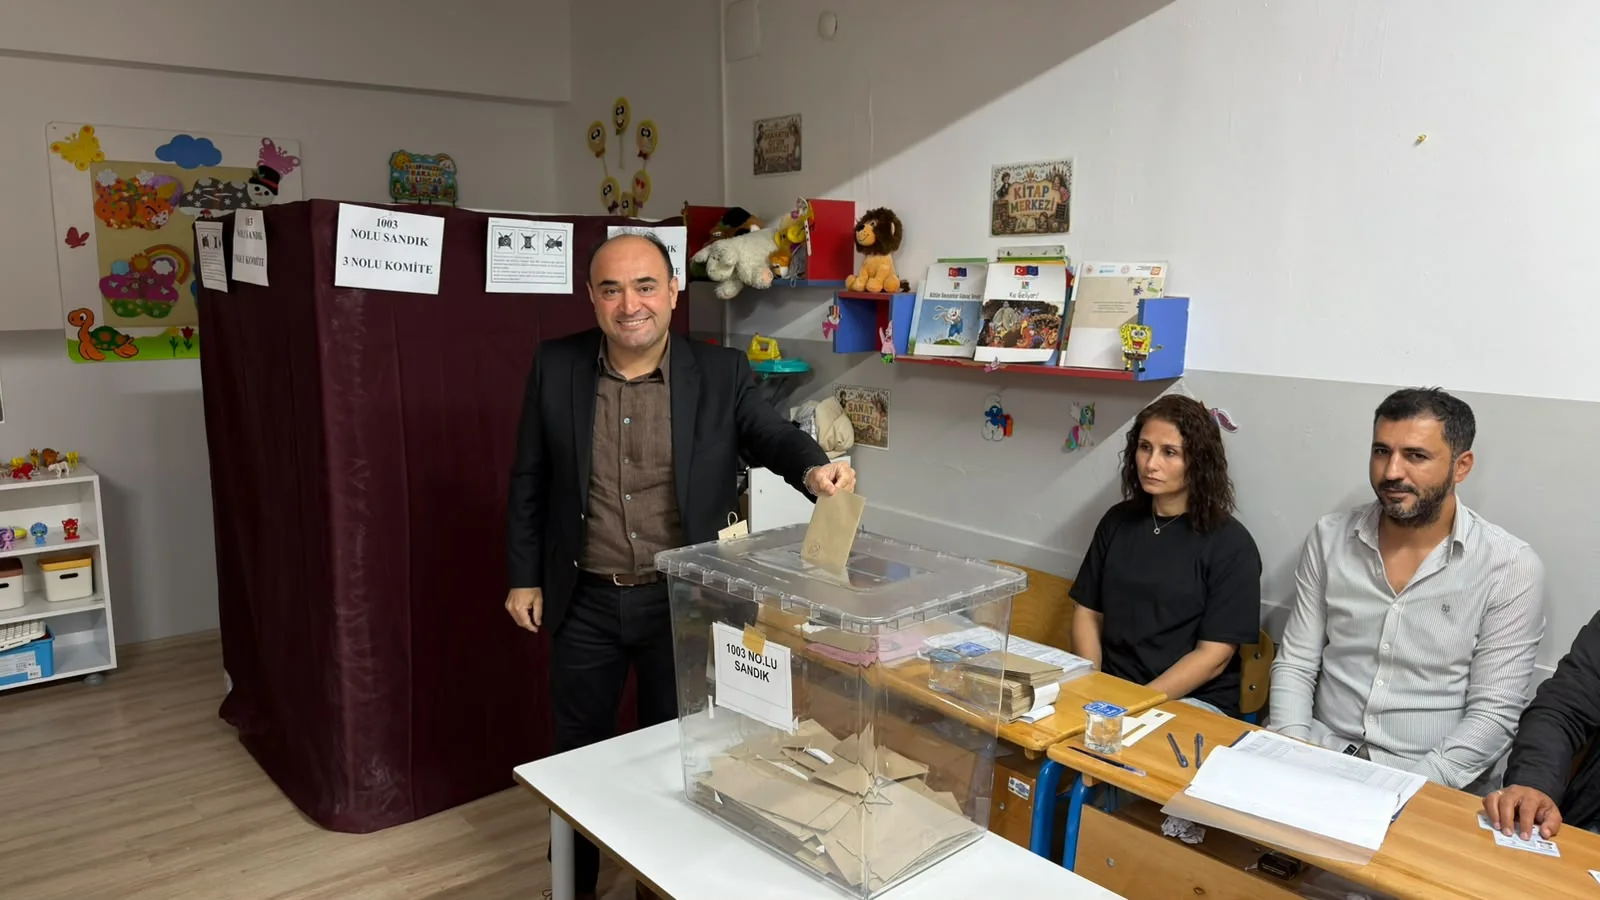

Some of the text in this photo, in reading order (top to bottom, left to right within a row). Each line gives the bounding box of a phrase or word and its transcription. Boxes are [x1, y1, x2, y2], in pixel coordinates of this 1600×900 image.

[1013, 184, 1050, 200] KİTAP
[376, 218, 399, 229] 1003
[350, 228, 429, 247] NOLU SANDIK
[342, 256, 433, 275] 3 NOLU KOMİTE
[847, 402, 874, 415] SANAT
[726, 643, 746, 659] 1003
[734, 660, 770, 683] SANDIK
